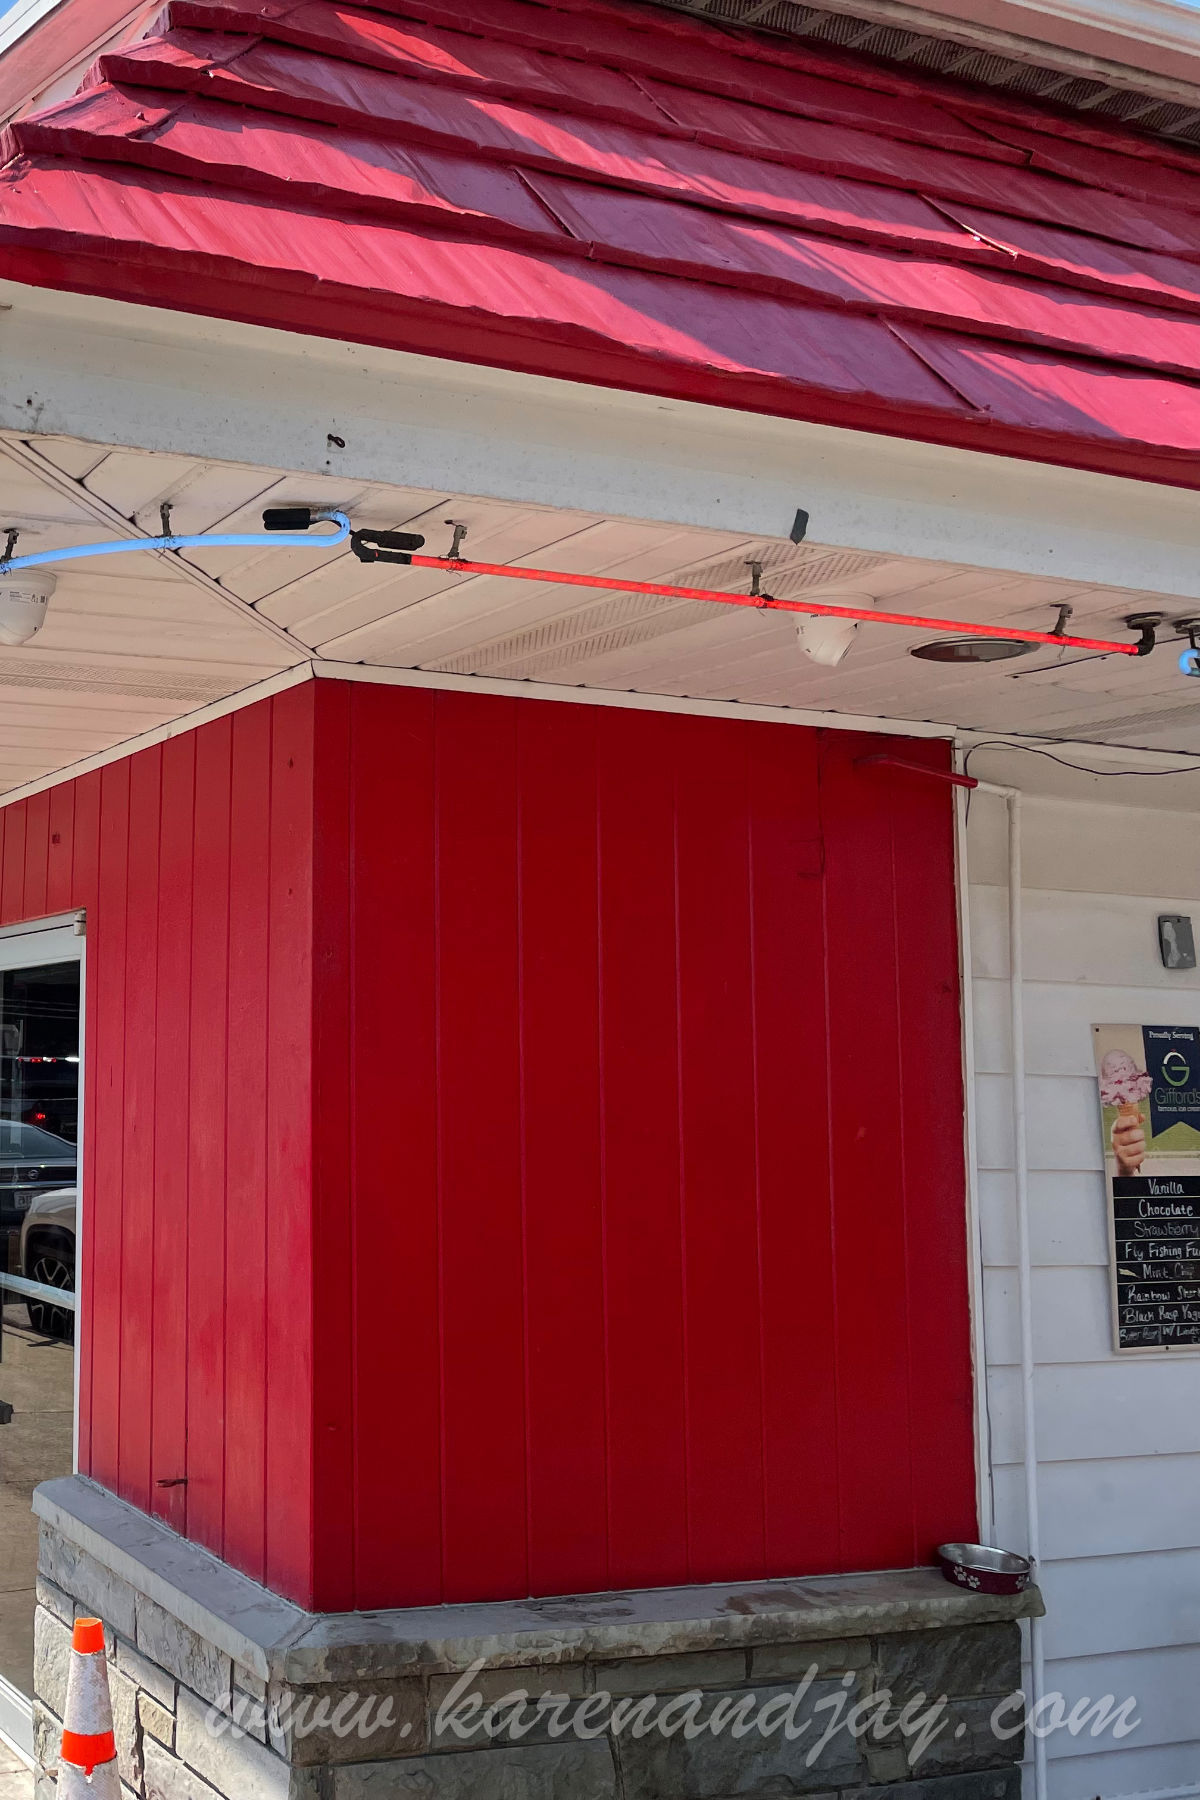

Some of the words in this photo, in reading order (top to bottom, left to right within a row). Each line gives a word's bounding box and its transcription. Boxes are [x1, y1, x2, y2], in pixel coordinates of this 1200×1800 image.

[1148, 1178, 1185, 1195] Vanilla
[1138, 1198, 1194, 1218] Chocolate
[1134, 1221, 1199, 1238] Strawberry
[1125, 1242, 1144, 1261] Fly
[1148, 1242, 1182, 1260] Fishing
[1123, 1307, 1155, 1323] Black
